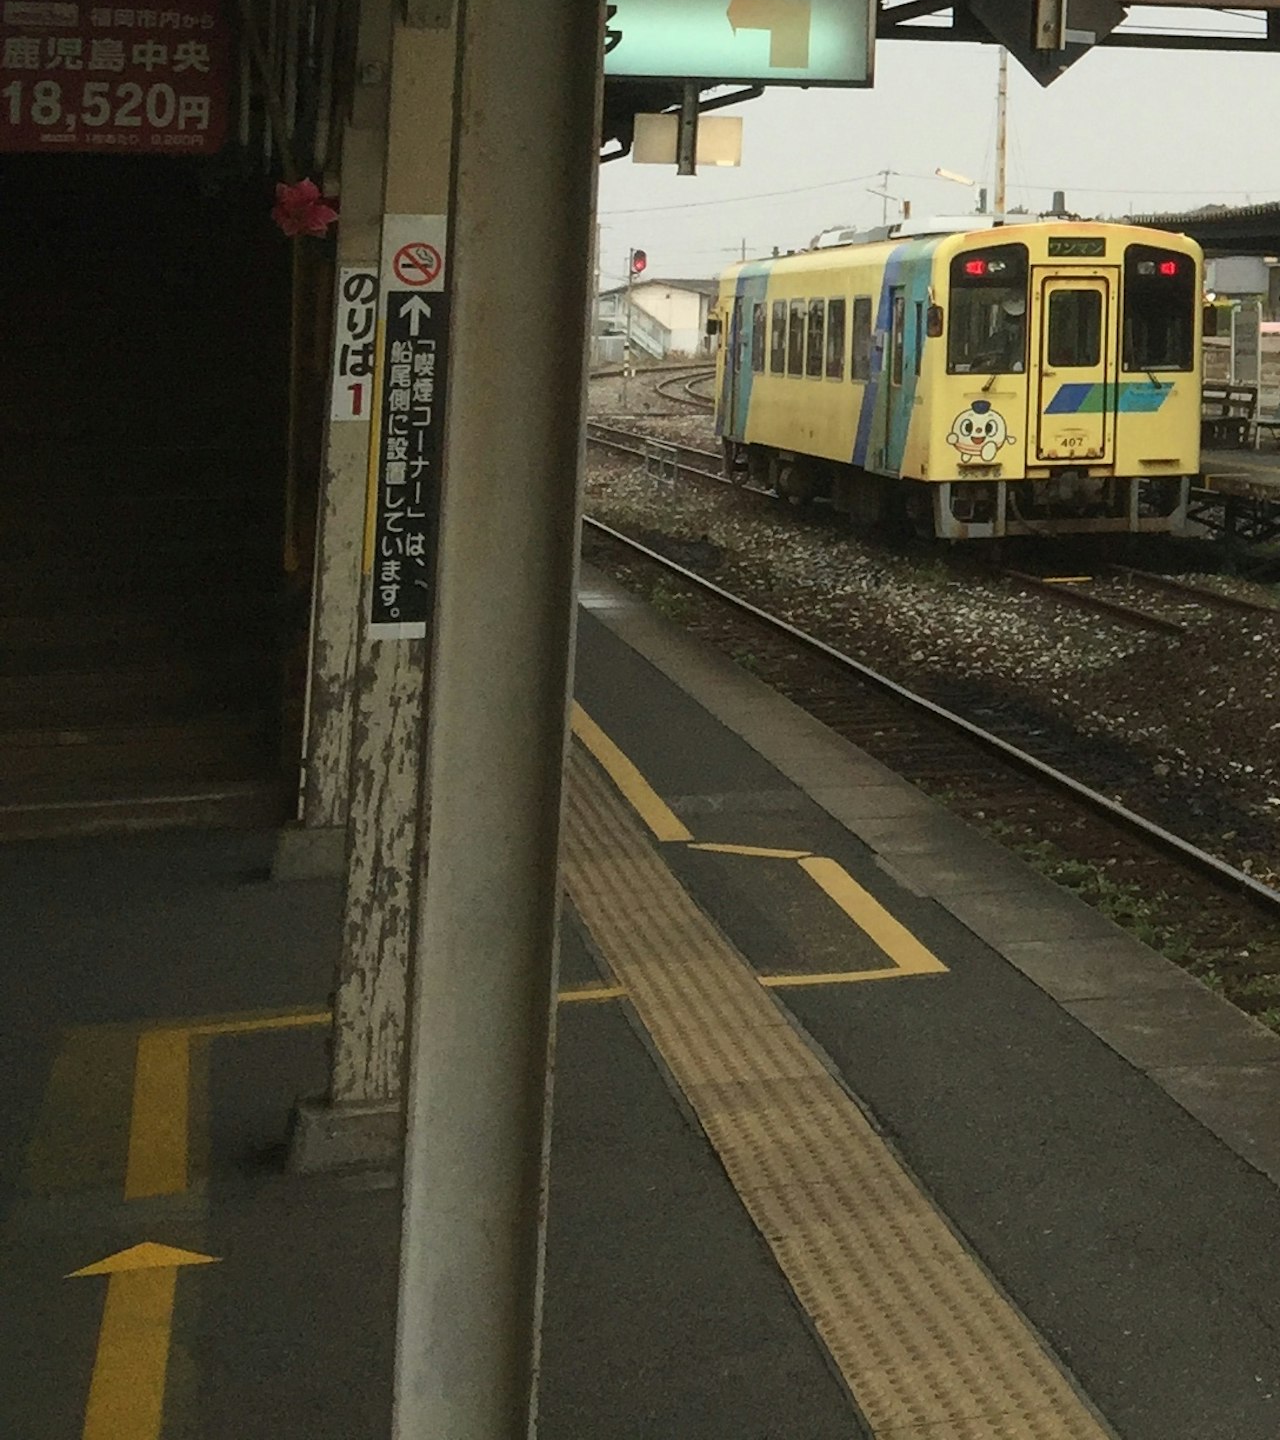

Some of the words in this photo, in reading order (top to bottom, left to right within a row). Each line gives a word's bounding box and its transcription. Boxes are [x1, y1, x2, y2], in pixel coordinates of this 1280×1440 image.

[3, 35, 210, 73] 鹿児島中央
[3, 79, 211, 132] 18,520円
[1049, 241, 1104, 254] ワンマン
[340, 273, 380, 377] のりば
[347, 383, 363, 416] 1
[1060, 437, 1084, 448] 407
[380, 340, 413, 618] 船尾側に設置しています。
